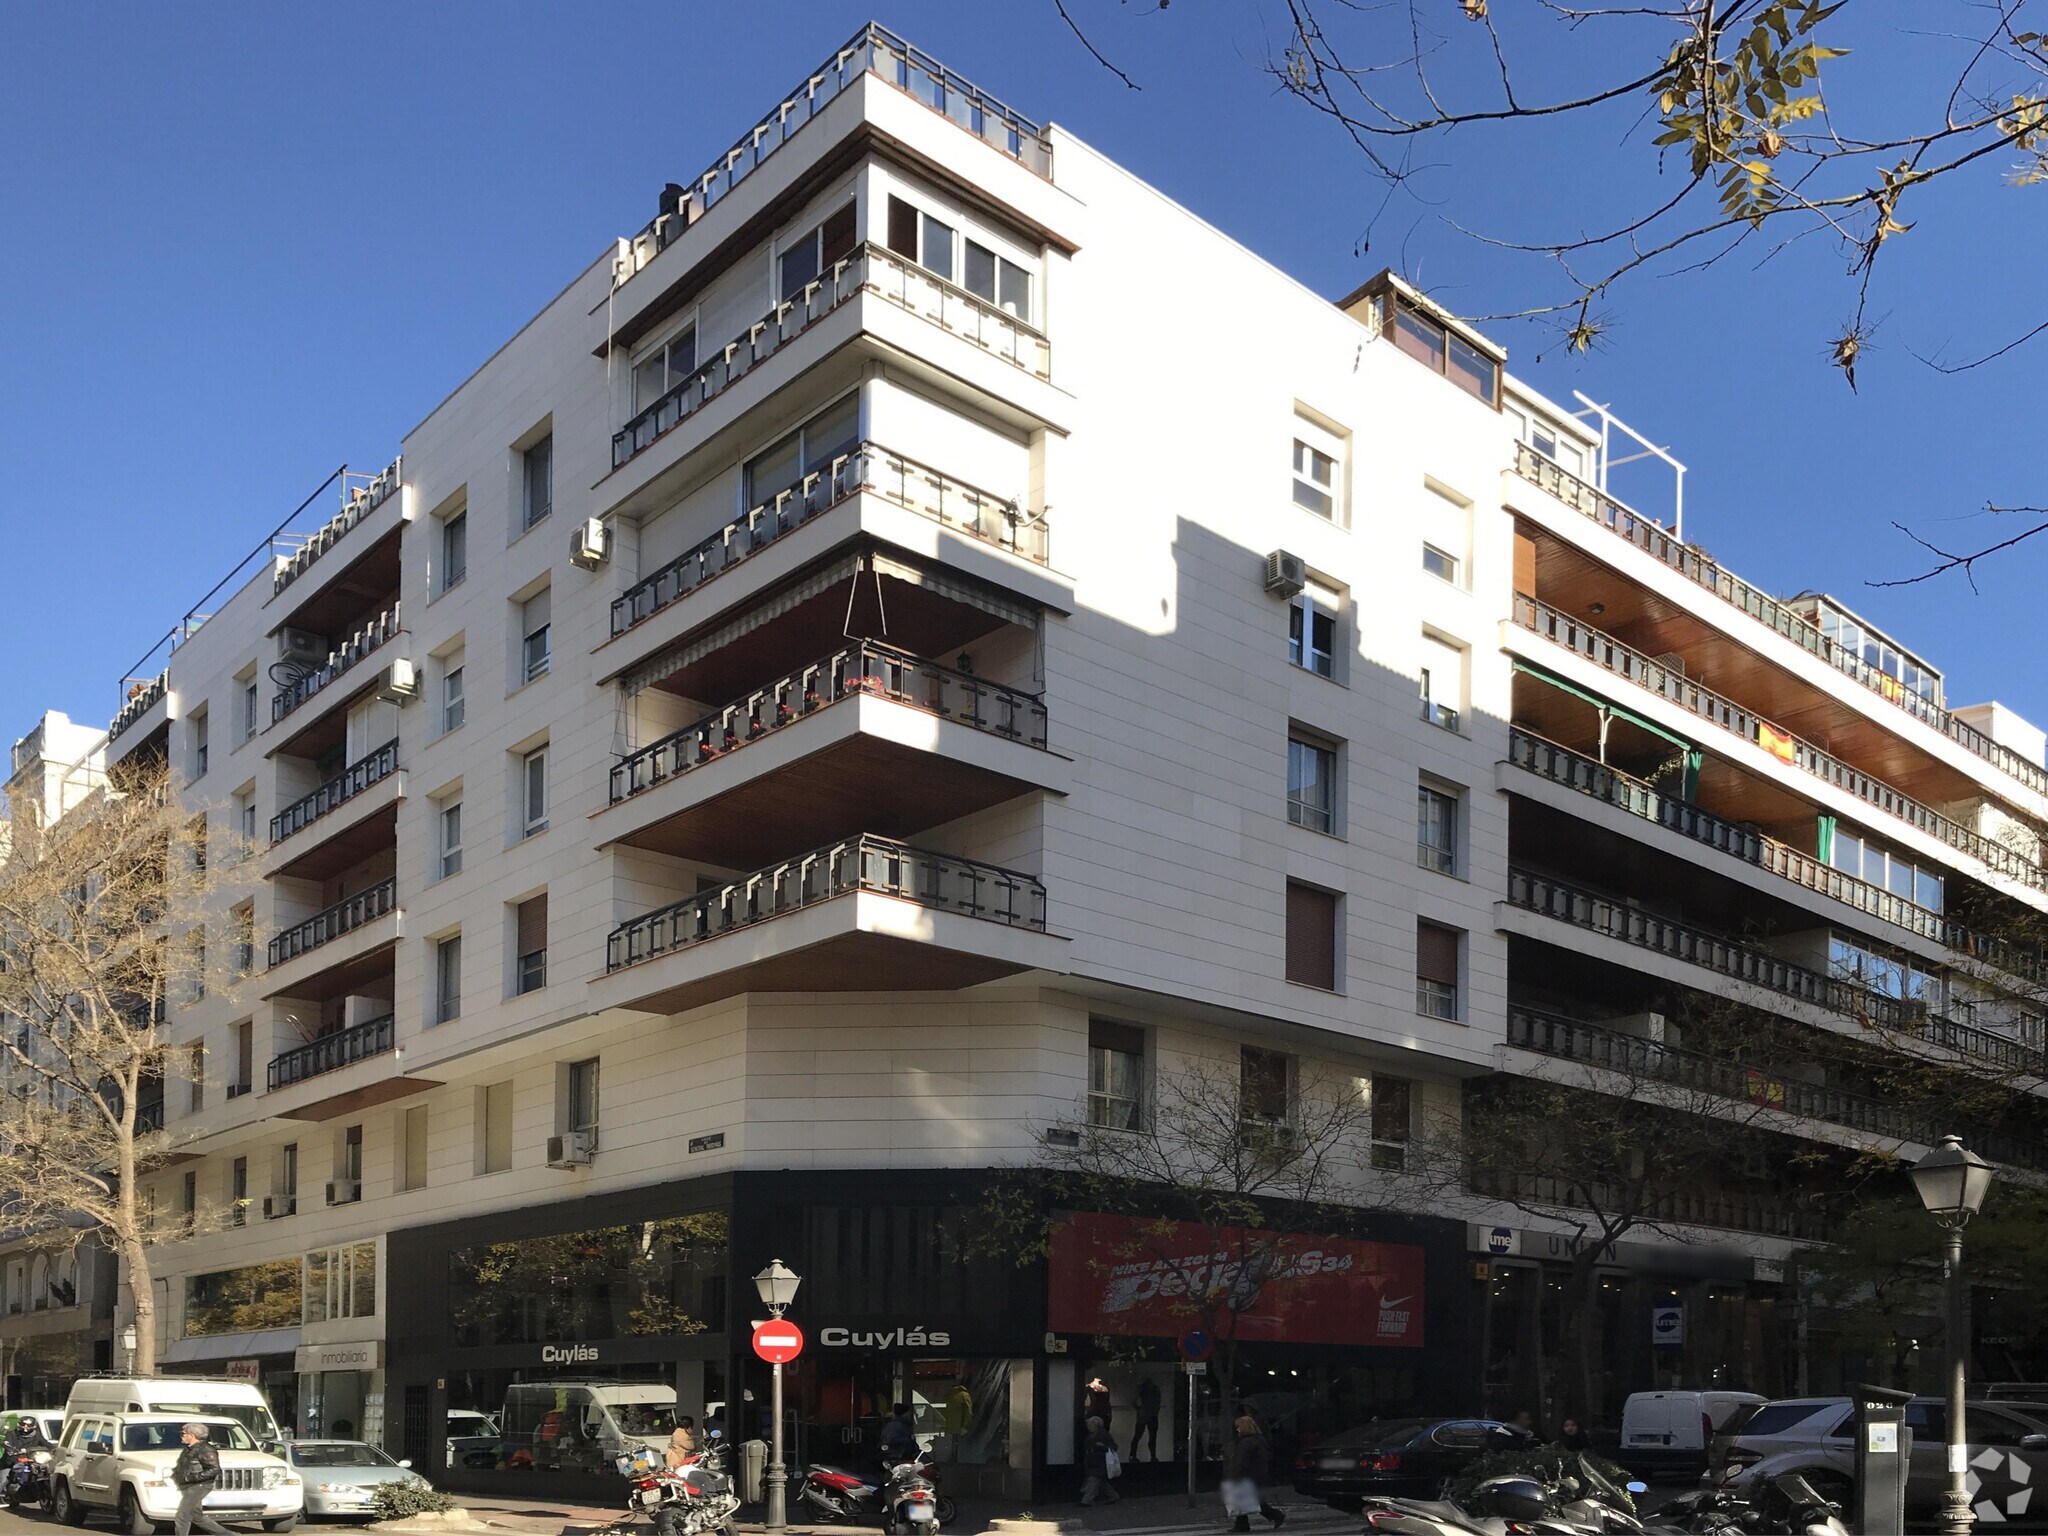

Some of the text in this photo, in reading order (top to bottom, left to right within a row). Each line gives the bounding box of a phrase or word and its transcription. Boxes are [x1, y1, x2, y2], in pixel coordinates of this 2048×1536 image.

[1489, 1234, 1511, 1247] ume
[1548, 1236, 1616, 1262] UNIN
[1111, 1261, 1151, 1276] NIKE
[820, 1325, 951, 1350] Cuylás
[320, 1350, 368, 1365] Inmobiliaria
[542, 1344, 599, 1365] Cuylás
